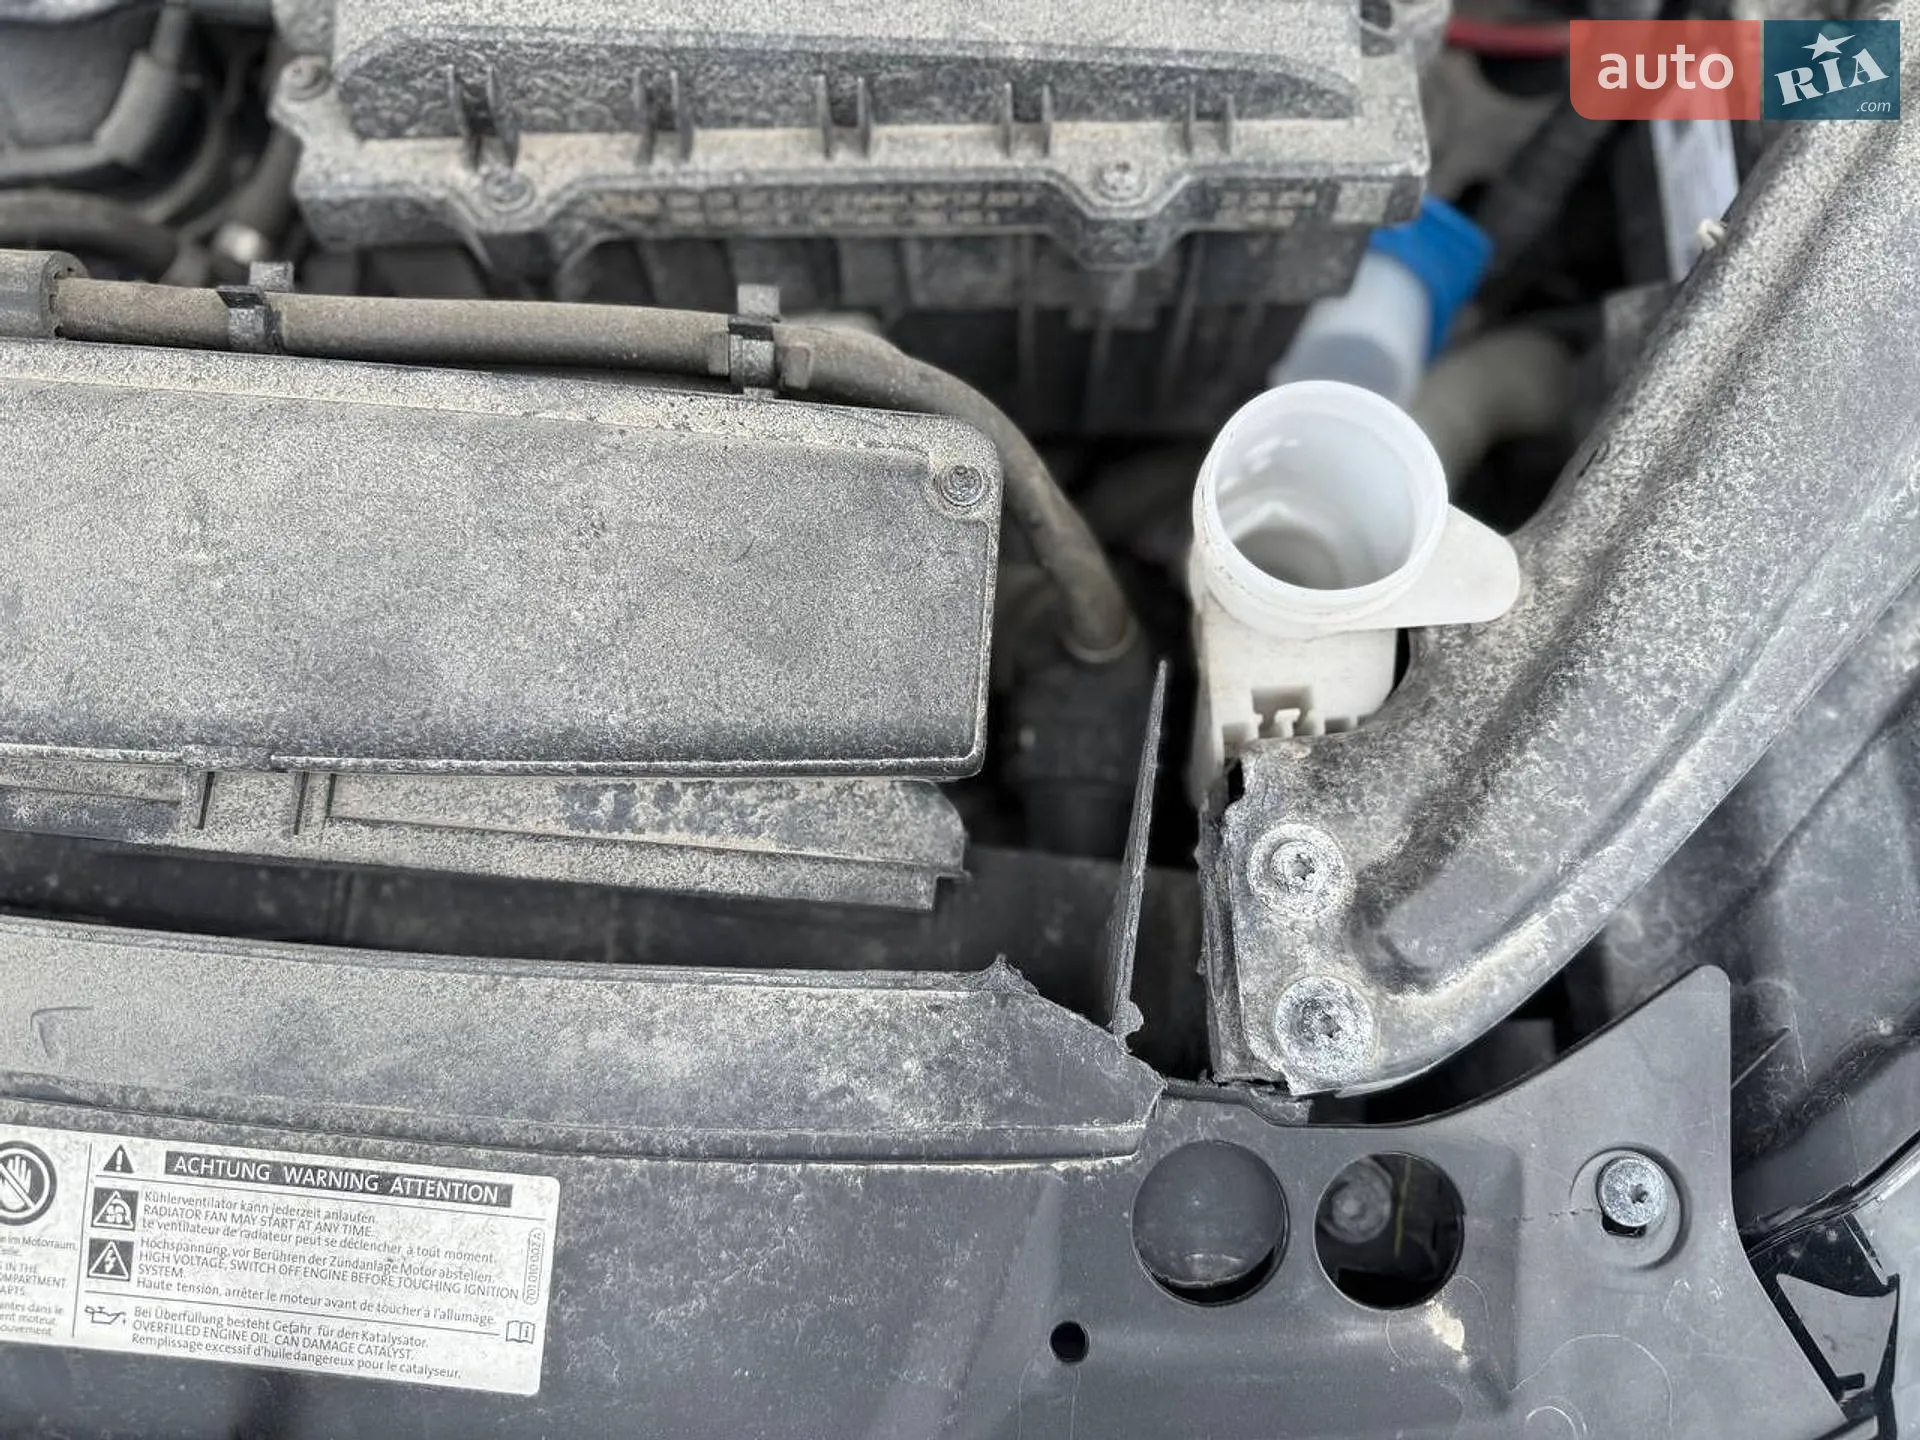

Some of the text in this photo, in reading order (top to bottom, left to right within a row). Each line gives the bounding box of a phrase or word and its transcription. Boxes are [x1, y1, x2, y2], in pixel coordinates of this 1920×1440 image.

[174, 1156, 498, 1203] ACHTUNG WARNING ATTENTION
[143, 1204, 201, 1219] RADIATOR
[204, 1210, 227, 1222] FAN
[232, 1213, 256, 1225] MAY
[260, 1216, 293, 1229] START
[297, 1220, 311, 1231] AT
[315, 1222, 342, 1234] ANY
[145, 1189, 237, 1211] Kühlerventilator
[240, 1200, 268, 1213] kann
[271, 1203, 320, 1221] jederzeit
[157, 1219, 219, 1235] ventilateur
[222, 1226, 236, 1236] de
[239, 1227, 291, 1242] radiateur
[296, 1234, 321, 1249] peut
[324, 1238, 338, 1248] se
[139, 1250, 170, 1263] HIGH
[230, 1259, 275, 1274] SWITCH
[278, 1264, 302, 1276] OFF
[303, 1266, 347, 1281] ENGINE
[350, 1271, 398, 1287] BEFORE
[398, 1276, 461, 1293] TOUCHING
[463, 1283, 519, 1300] IGNITION
[232, 1248, 250, 1257] vor
[253, 1248, 305, 1263] Berühren
[308, 1254, 326, 1265] der
[401, 1264, 437, 1277] Motor
[136, 1277, 172, 1290] Haute
[224, 1286, 264, 1300] arrêter
[267, 1290, 276, 1300] le
[279, 1293, 321, 1305] moteur
[325, 1296, 356, 1309] avant
[359, 1300, 372, 1311] de
[376, 1301, 421, 1316] toucher
[132, 1320, 200, 1336] OVERFILLED
[203, 1327, 247, 1341] ENGINE
[250, 1332, 268, 1343] OIL
[274, 1335, 299, 1346] CAN
[301, 1338, 354, 1353] DAMAGE
[134, 1306, 152, 1318] Bei
[154, 1307, 224, 1327] Überfüllung
[226, 1315, 270, 1330] besteht
[272, 1320, 311, 1334] Gefahr
[317, 1325, 333, 1337] für
[337, 1327, 358, 1339] den
[131, 1333, 203, 1352] Remplissage
[205, 1341, 251, 1355] excessif
[293, 1350, 353, 1369] dangereux
[356, 1358, 383, 1372] pour
[387, 1361, 396, 1371] le
